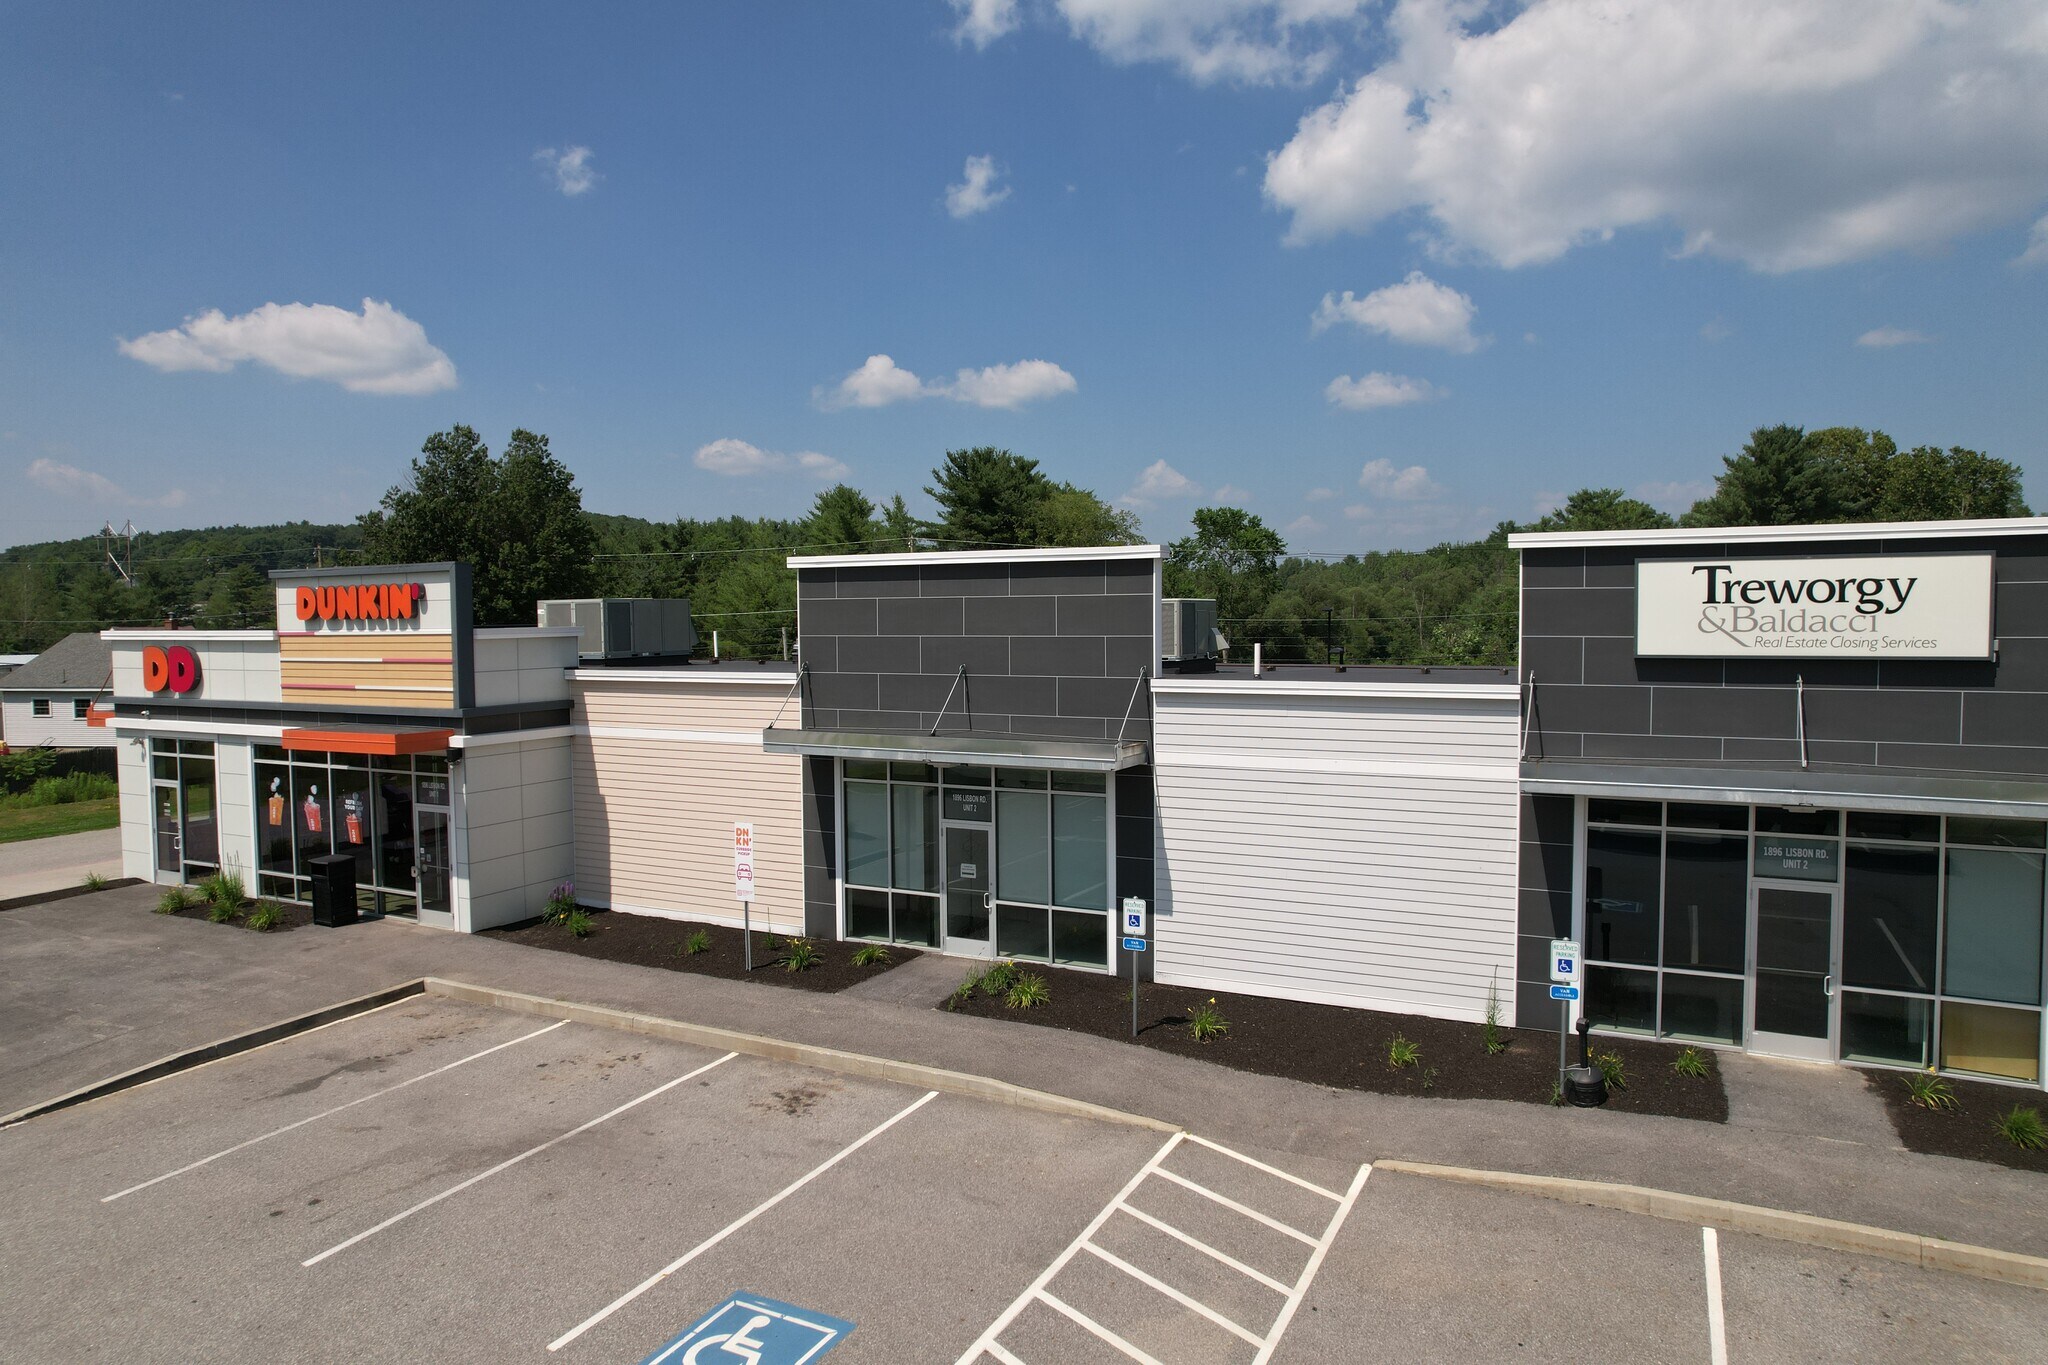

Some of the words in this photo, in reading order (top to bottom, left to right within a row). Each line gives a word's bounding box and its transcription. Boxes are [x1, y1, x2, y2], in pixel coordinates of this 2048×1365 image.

[1692, 565, 1917, 615] Treworgy
[296, 583, 423, 621] DUNKIN'
[1754, 636, 1783, 648] Real
[1785, 636, 1828, 648] Estate
[1830, 635, 1878, 652] Closing
[1881, 635, 1938, 649] Services
[963, 794, 979, 802] LISBON
[736, 827, 749, 837] DN
[736, 836, 751, 846] KN'
[1763, 847, 1783, 857] 1896
[1785, 848, 1814, 858] LISBON
[1815, 849, 1829, 859] RD.
[1783, 859, 1801, 869] UNIT
[1802, 860, 1808, 870] 2
[1553, 944, 1578, 952] RESERVED
[1555, 951, 1576, 959] PARKING
